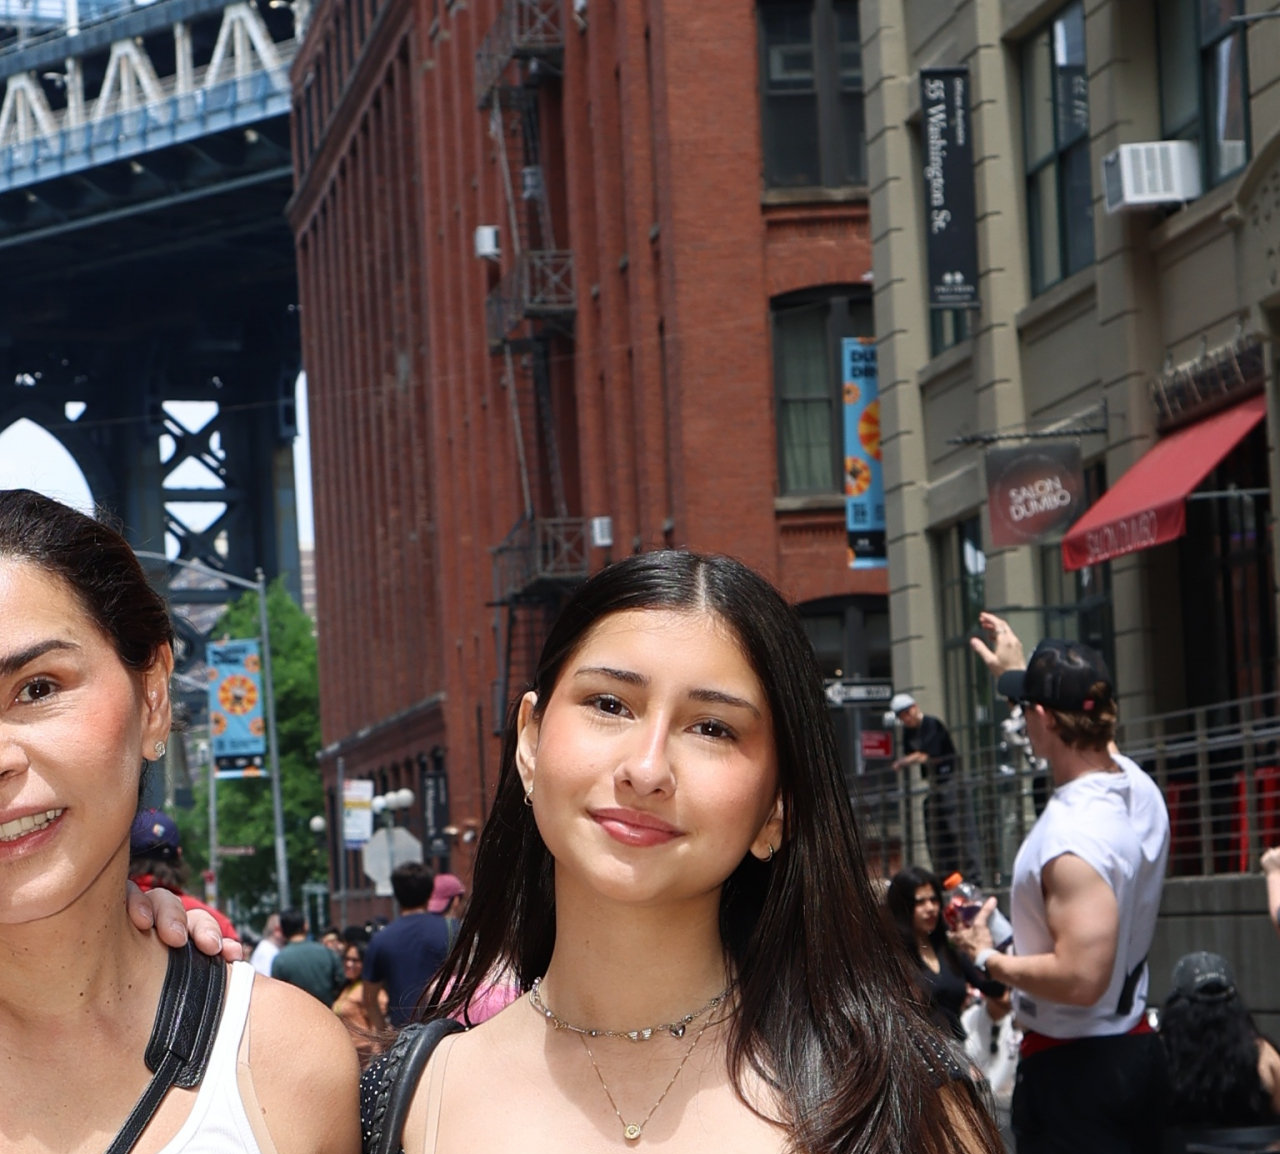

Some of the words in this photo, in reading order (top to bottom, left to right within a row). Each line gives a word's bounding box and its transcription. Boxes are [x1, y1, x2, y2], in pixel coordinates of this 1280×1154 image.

[924, 78, 946, 100] 55
[923, 103, 948, 207] Washington
[931, 209, 952, 235] St.
[1009, 475, 1063, 505] SALON
[1009, 489, 1071, 521] DUMBO
